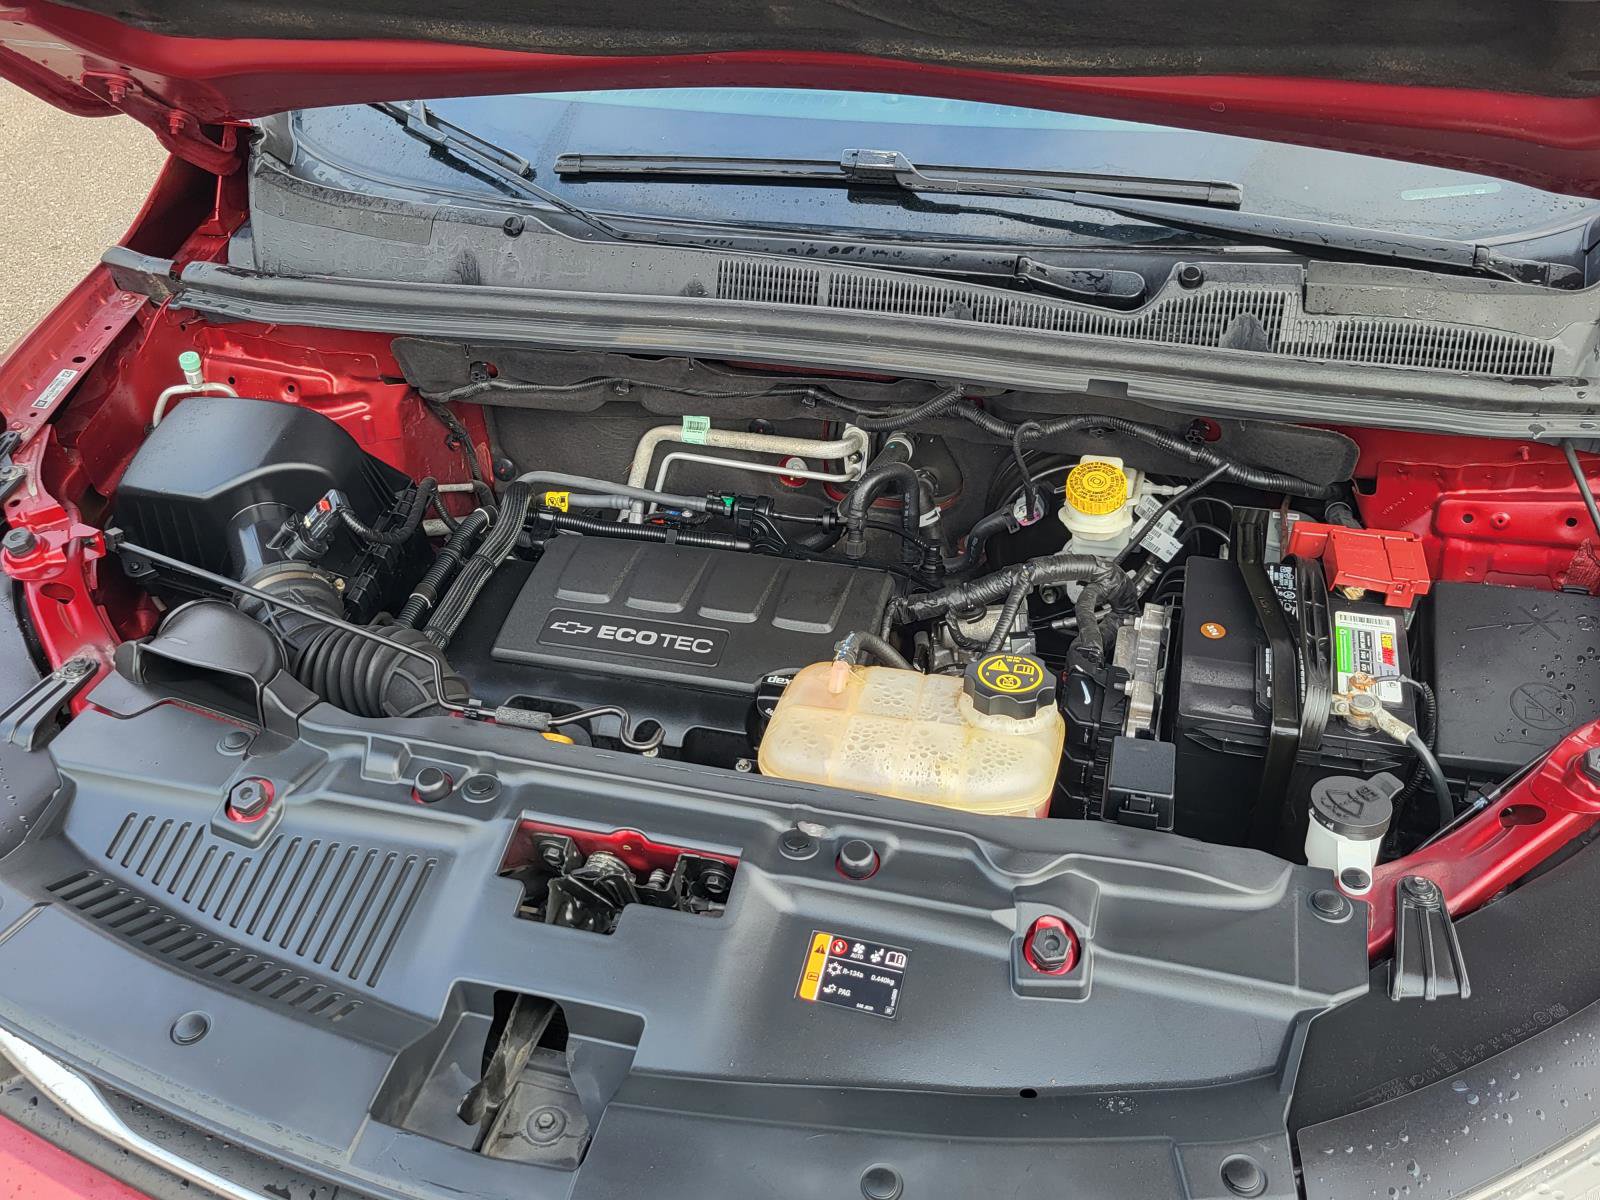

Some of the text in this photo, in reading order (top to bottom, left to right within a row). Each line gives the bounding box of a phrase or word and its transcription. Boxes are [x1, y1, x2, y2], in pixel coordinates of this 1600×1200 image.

[597, 625, 714, 654] ECOTEC
[842, 967, 864, 978] R-134a
[837, 987, 851, 997] PAG
